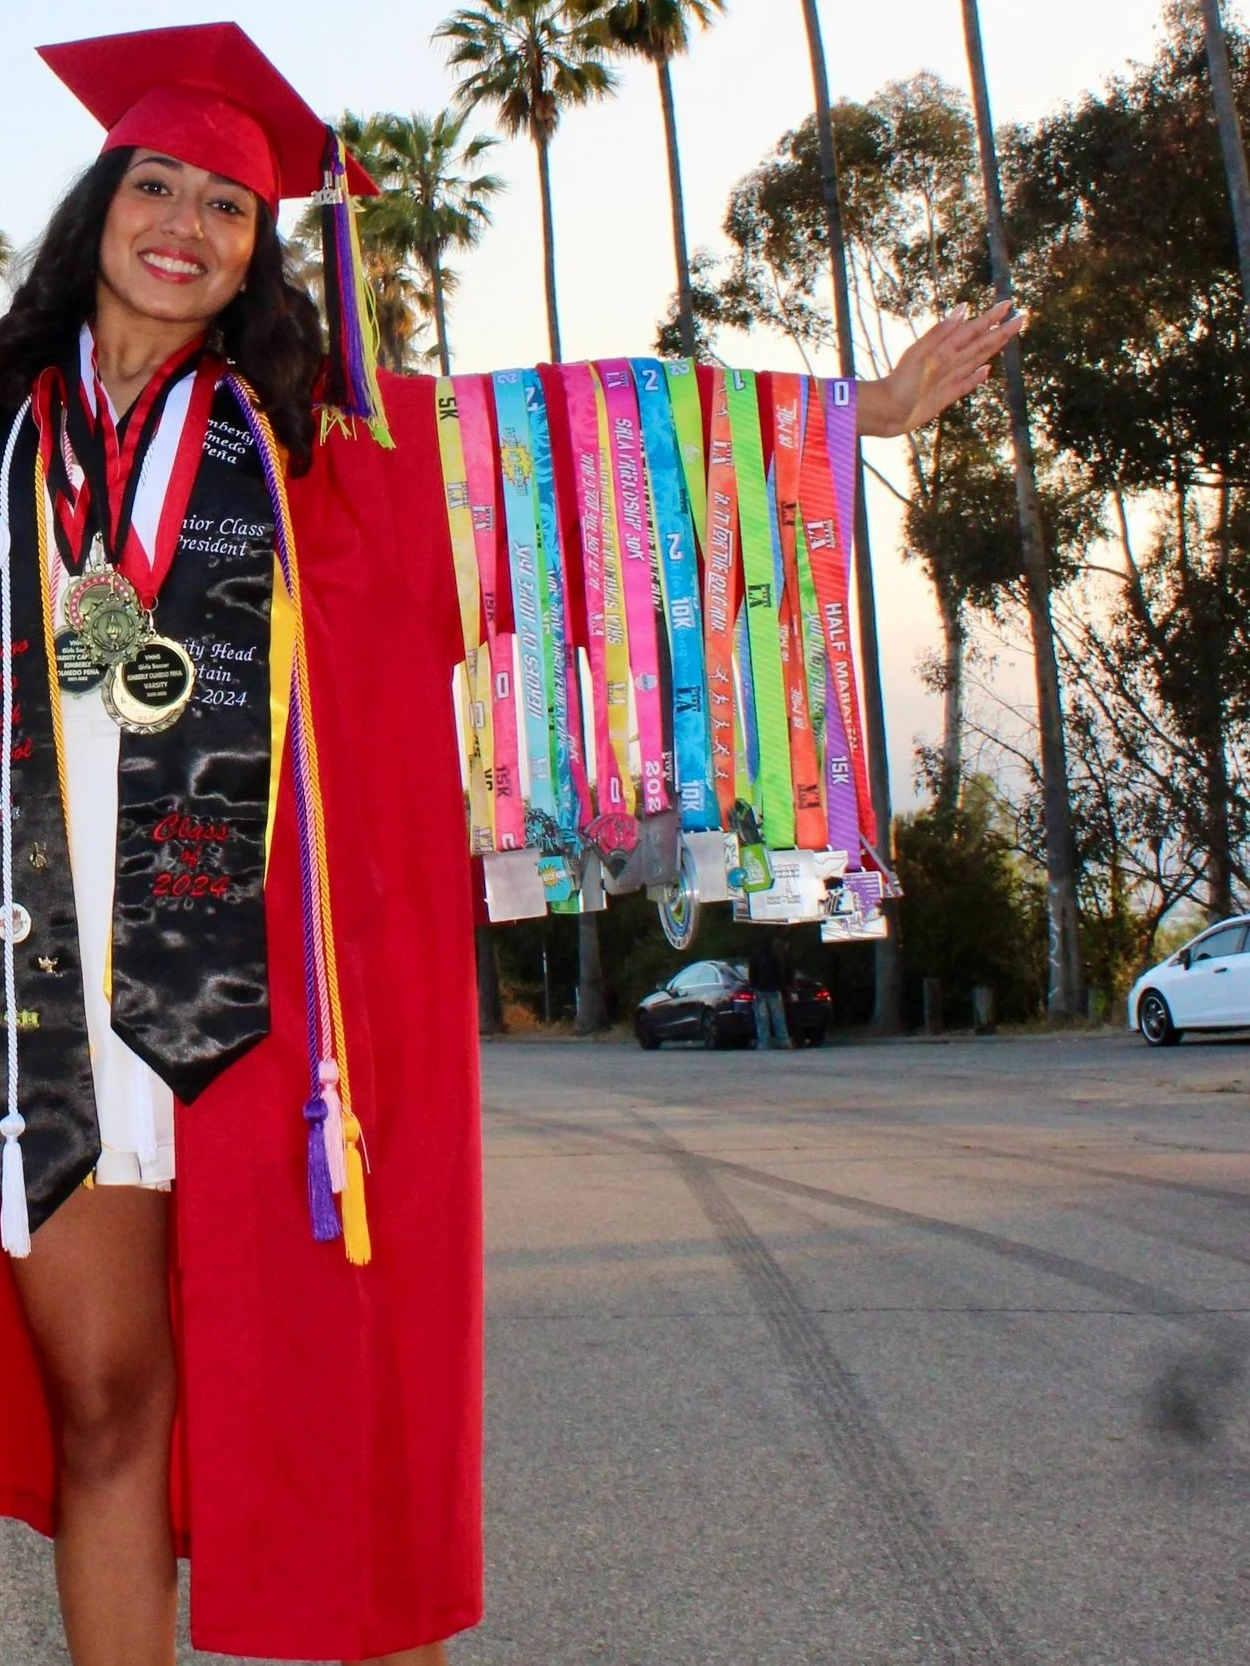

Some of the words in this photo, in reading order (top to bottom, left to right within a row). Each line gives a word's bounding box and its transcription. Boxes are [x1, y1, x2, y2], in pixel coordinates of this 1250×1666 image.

[641, 369, 659, 391] 2
[438, 396, 460, 421] 5K
[774, 404, 794, 433] MILE
[614, 417, 635, 450] SRLA
[618, 452, 643, 531] FRIENDSHIP
[219, 518, 266, 537] Class
[585, 510, 598, 531] THE
[625, 533, 645, 561] 30K
[666, 532, 684, 561] 2
[711, 524, 733, 549] FOR
[513, 542, 534, 577] 15K
[712, 550, 729, 574] THE
[516, 578, 536, 623] HOPE
[707, 571, 728, 607] LONG
[670, 596, 696, 630] 10K
[824, 601, 847, 652] HALF
[180, 638, 206, 661] ity
[210, 642, 257, 662] Head
[520, 624, 539, 650] OF
[63, 661, 92, 669] KIMBERLY
[126, 673, 149, 681] KIMBERLY
[194, 664, 232, 682] tain
[143, 681, 168, 690] VARSITY
[187, 689, 247, 707] -2024
[523, 653, 543, 720] HEROES
[790, 686, 804, 715] MILE
[495, 764, 513, 798] 15K
[830, 755, 850, 785] 15K
[681, 779, 702, 812] 10K
[153, 812, 229, 843] Class
[152, 871, 230, 899] 2024
